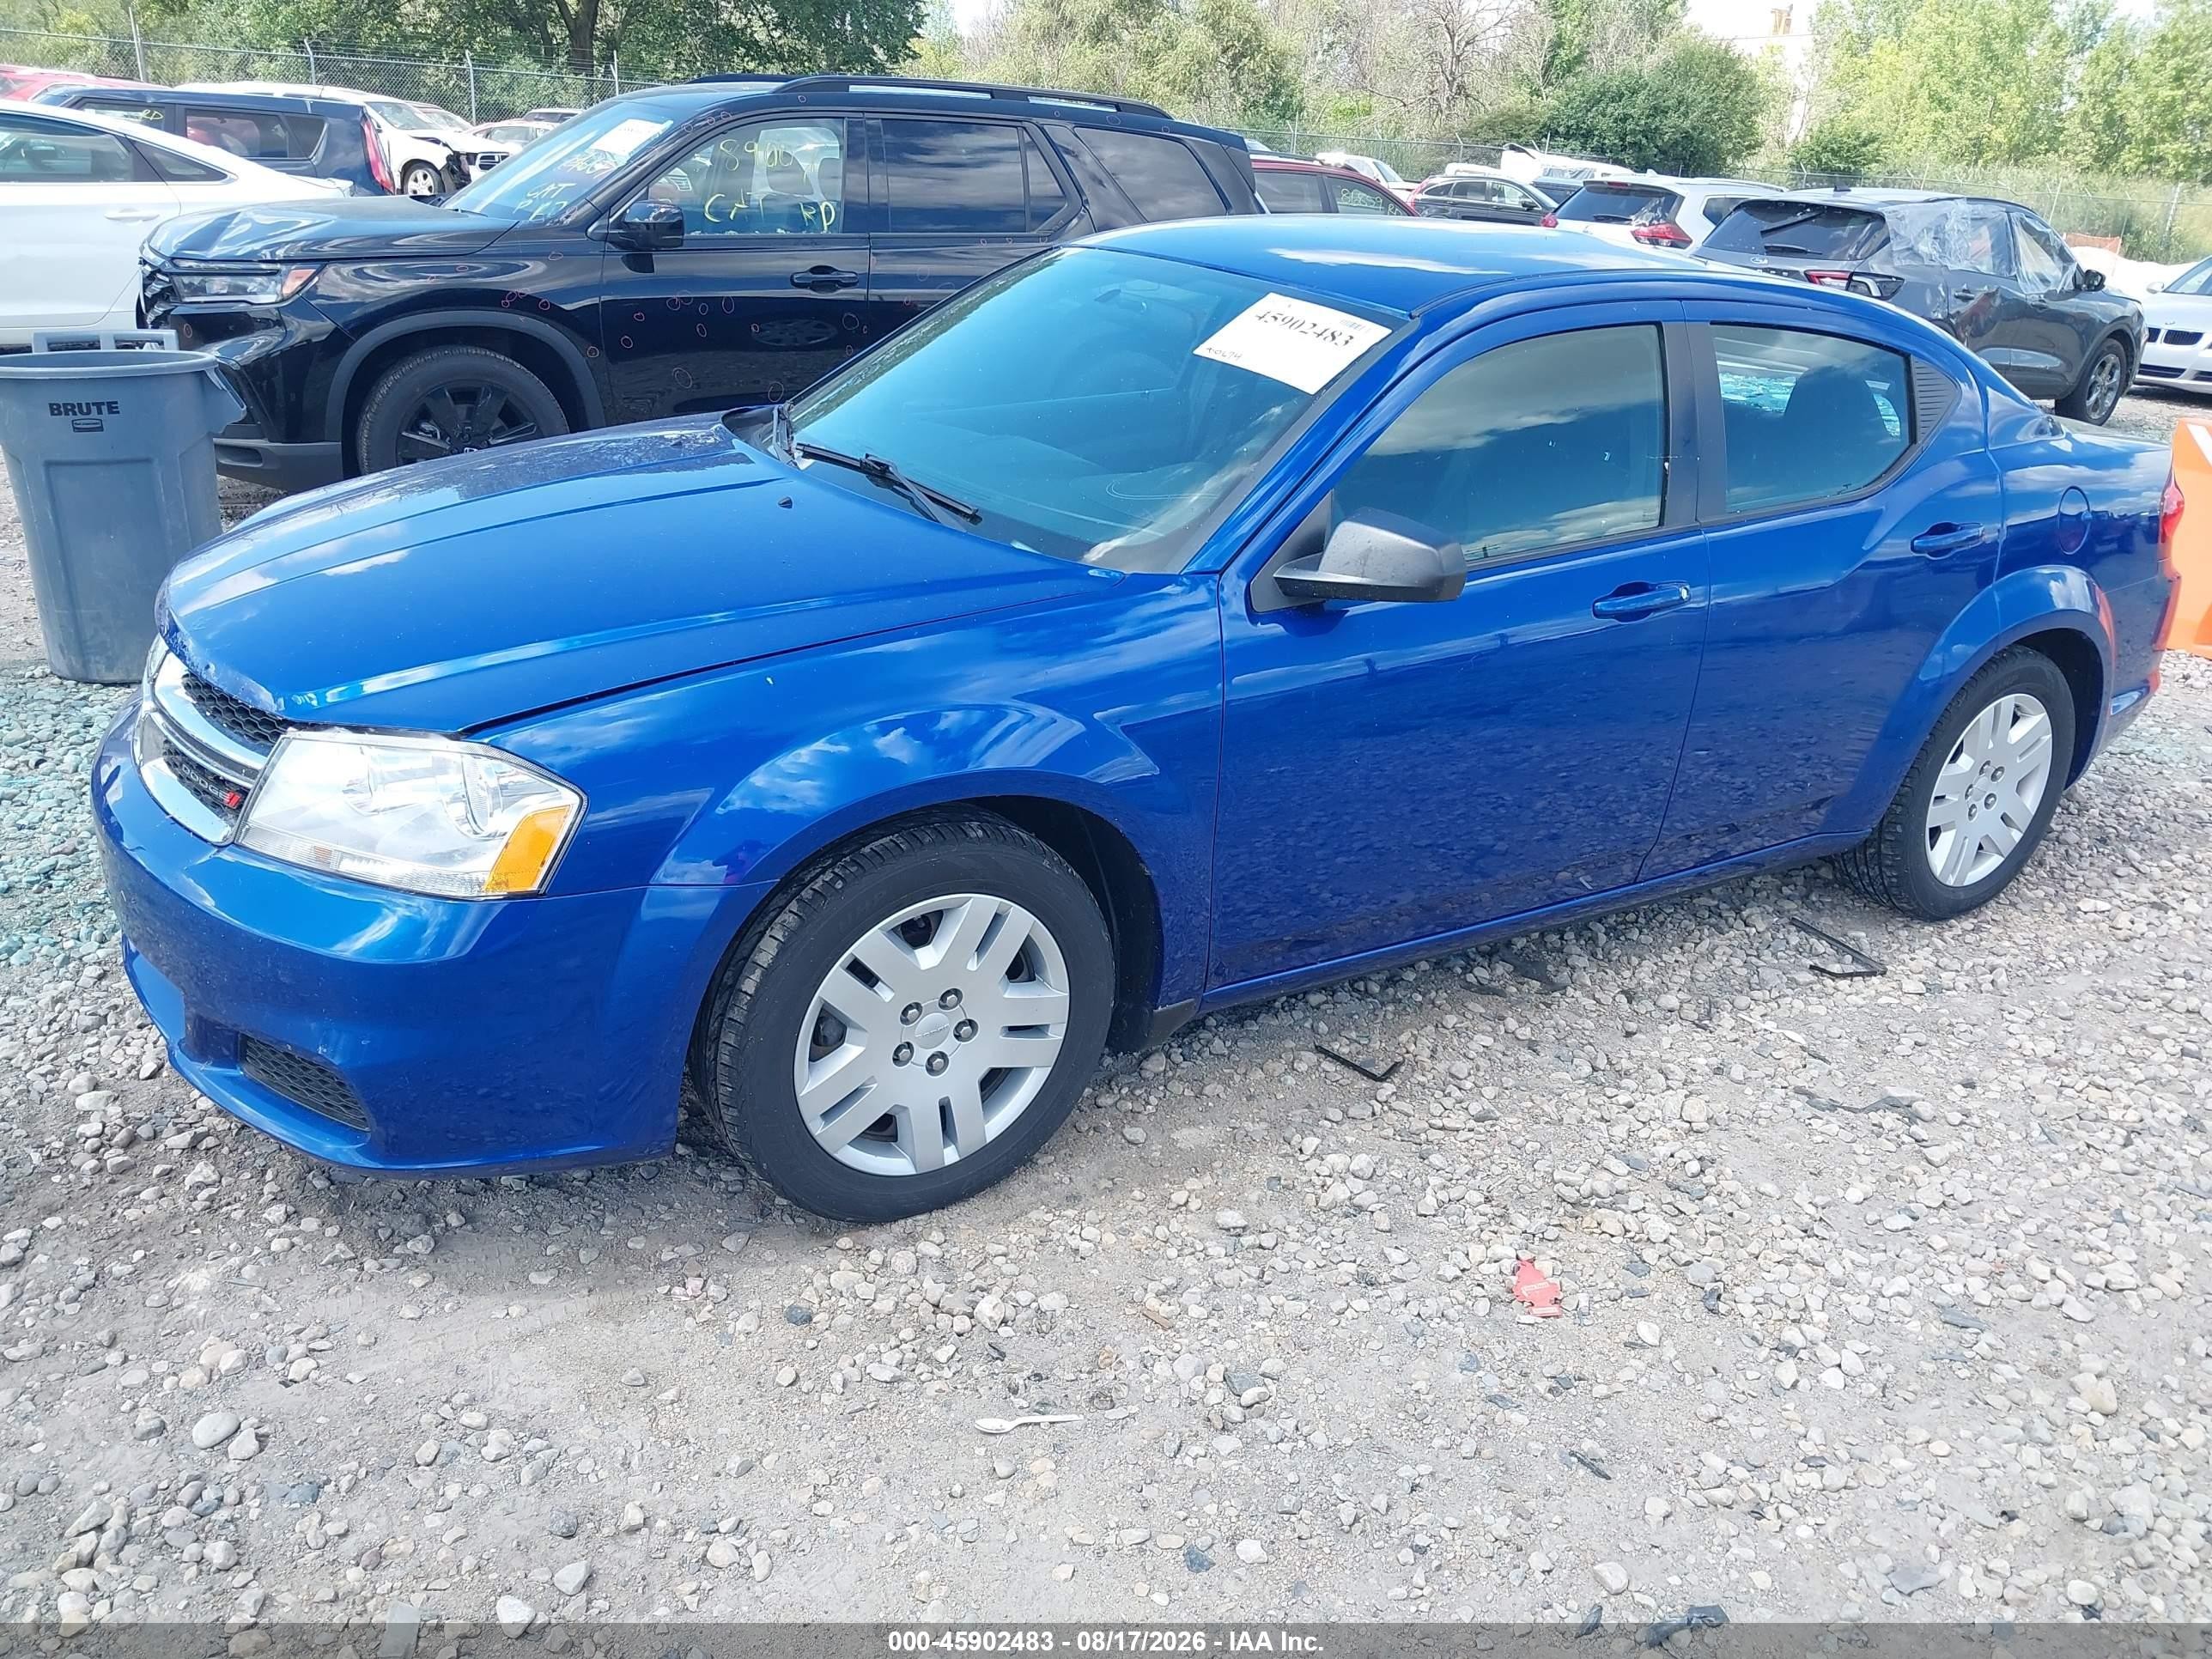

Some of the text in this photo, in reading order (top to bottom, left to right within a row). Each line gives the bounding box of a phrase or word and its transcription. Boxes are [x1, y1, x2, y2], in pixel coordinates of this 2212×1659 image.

[1255, 309, 1354, 348] 45902483
[48, 400, 120, 416] BRUTE
[182, 763, 230, 802] DODGE
